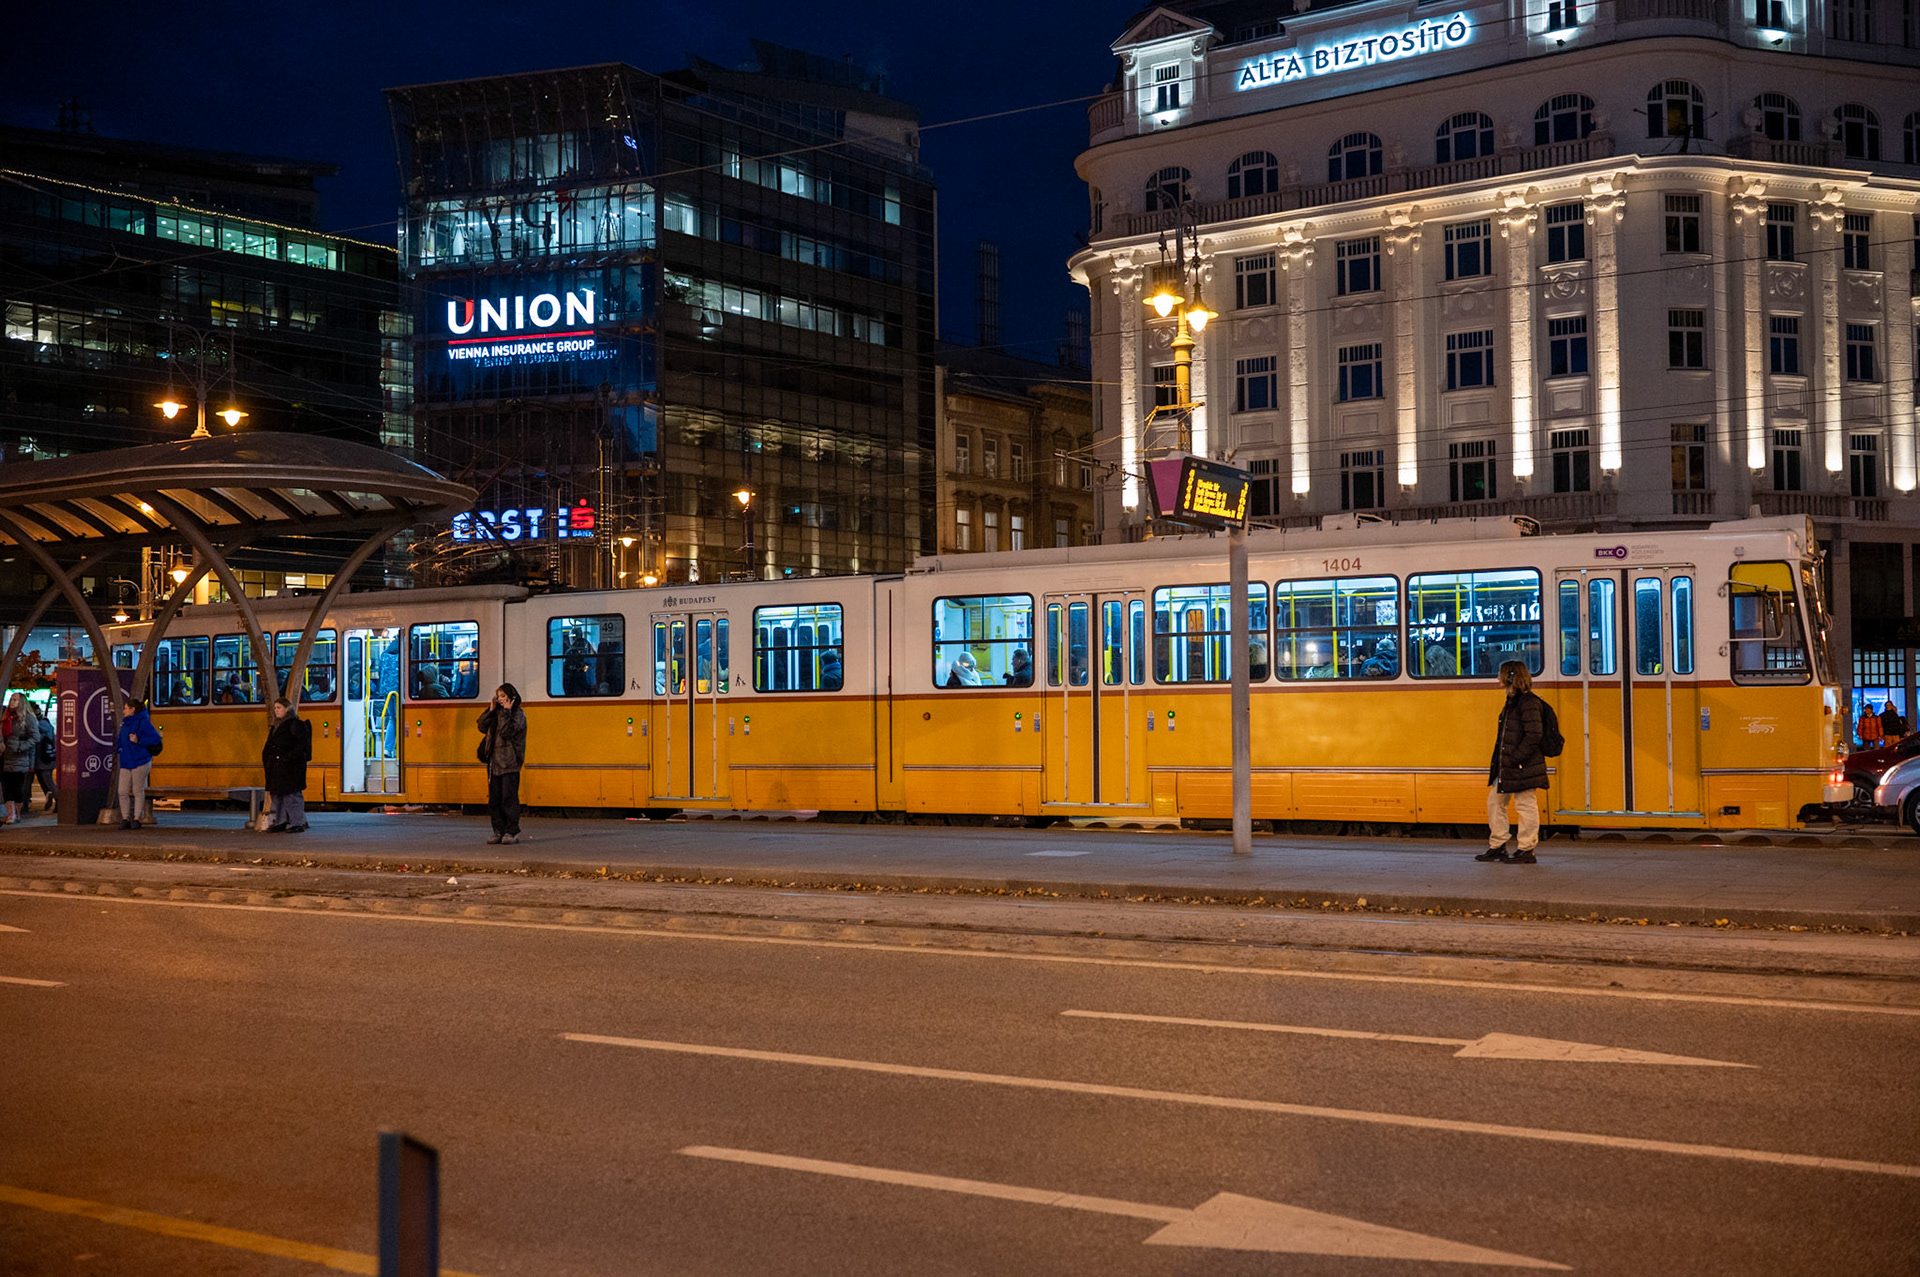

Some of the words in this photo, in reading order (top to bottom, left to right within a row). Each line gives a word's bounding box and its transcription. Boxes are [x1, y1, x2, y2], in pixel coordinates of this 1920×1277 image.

[1240, 55, 1302, 86] ALFA
[1315, 14, 1466, 70] BIZTOSÍTÓ
[447, 289, 595, 335] UNION
[448, 346, 490, 360] VIENNA
[491, 341, 554, 357] INSURANCE
[556, 339, 595, 352] GROUP
[1597, 549, 1614, 557] BKK
[1322, 557, 1362, 572] 1404
[679, 596, 716, 605] BUDAPEST
[602, 622, 614, 632] 49
